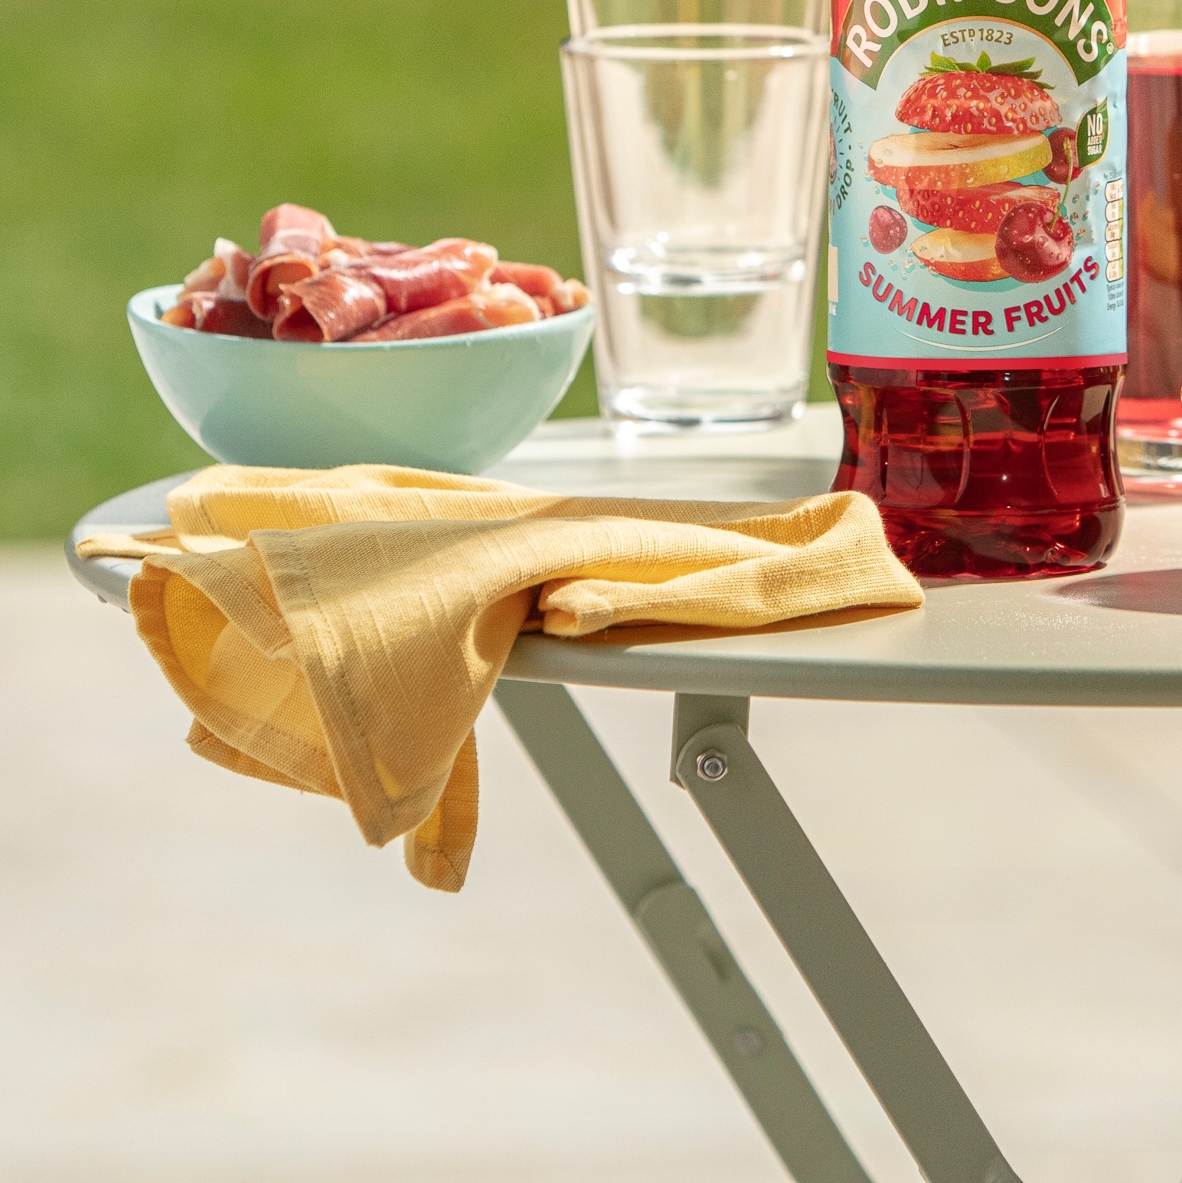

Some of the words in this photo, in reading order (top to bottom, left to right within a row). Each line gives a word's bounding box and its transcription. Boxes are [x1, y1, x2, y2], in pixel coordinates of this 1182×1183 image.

[978, 27, 1014, 46] 1823
[831, 88, 853, 135] RUIT
[1086, 112, 1104, 137] NO
[1086, 144, 1103, 156] SUGAR
[835, 158, 855, 210] DROP
[858, 261, 995, 336] SUMMER
[1003, 255, 1100, 333] FRUITS
